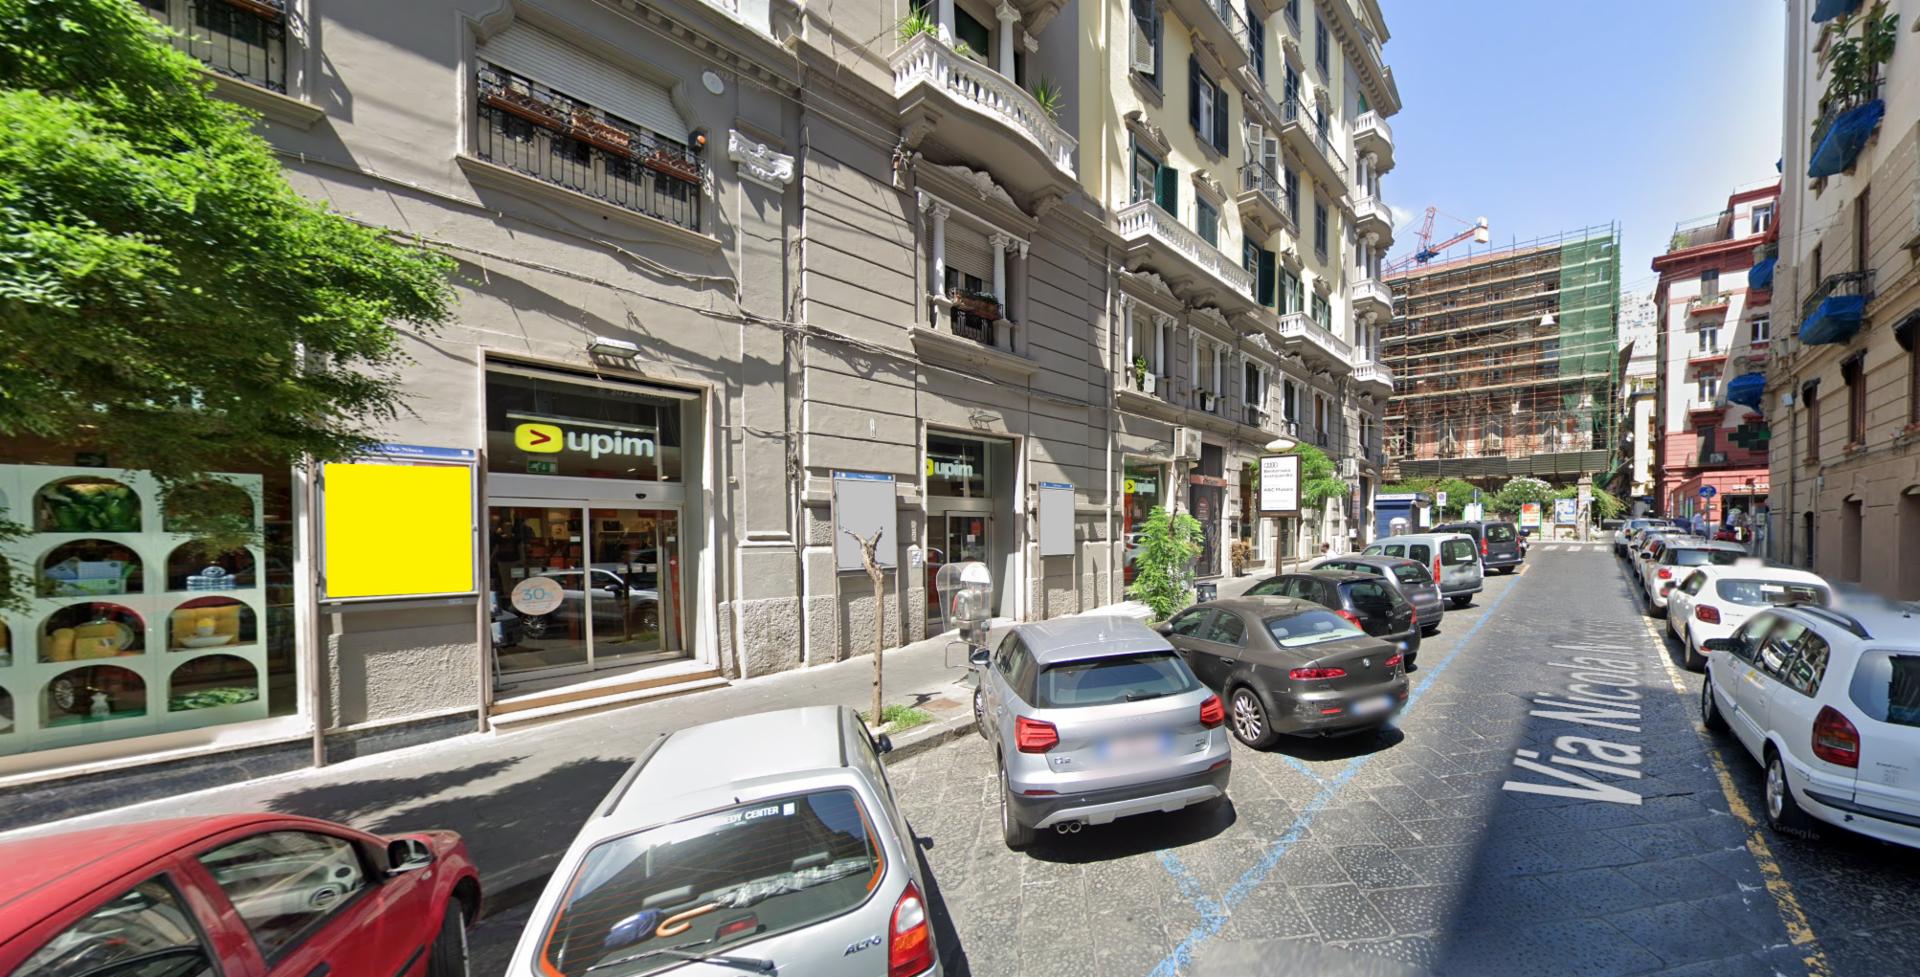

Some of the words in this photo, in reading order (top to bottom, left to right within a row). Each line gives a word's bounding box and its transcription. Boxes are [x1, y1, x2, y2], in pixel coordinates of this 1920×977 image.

[567, 430, 654, 459] upim
[934, 460, 973, 479] upim
[744, 806, 779, 820] CENTER
[844, 936, 882, 957] ALTO
